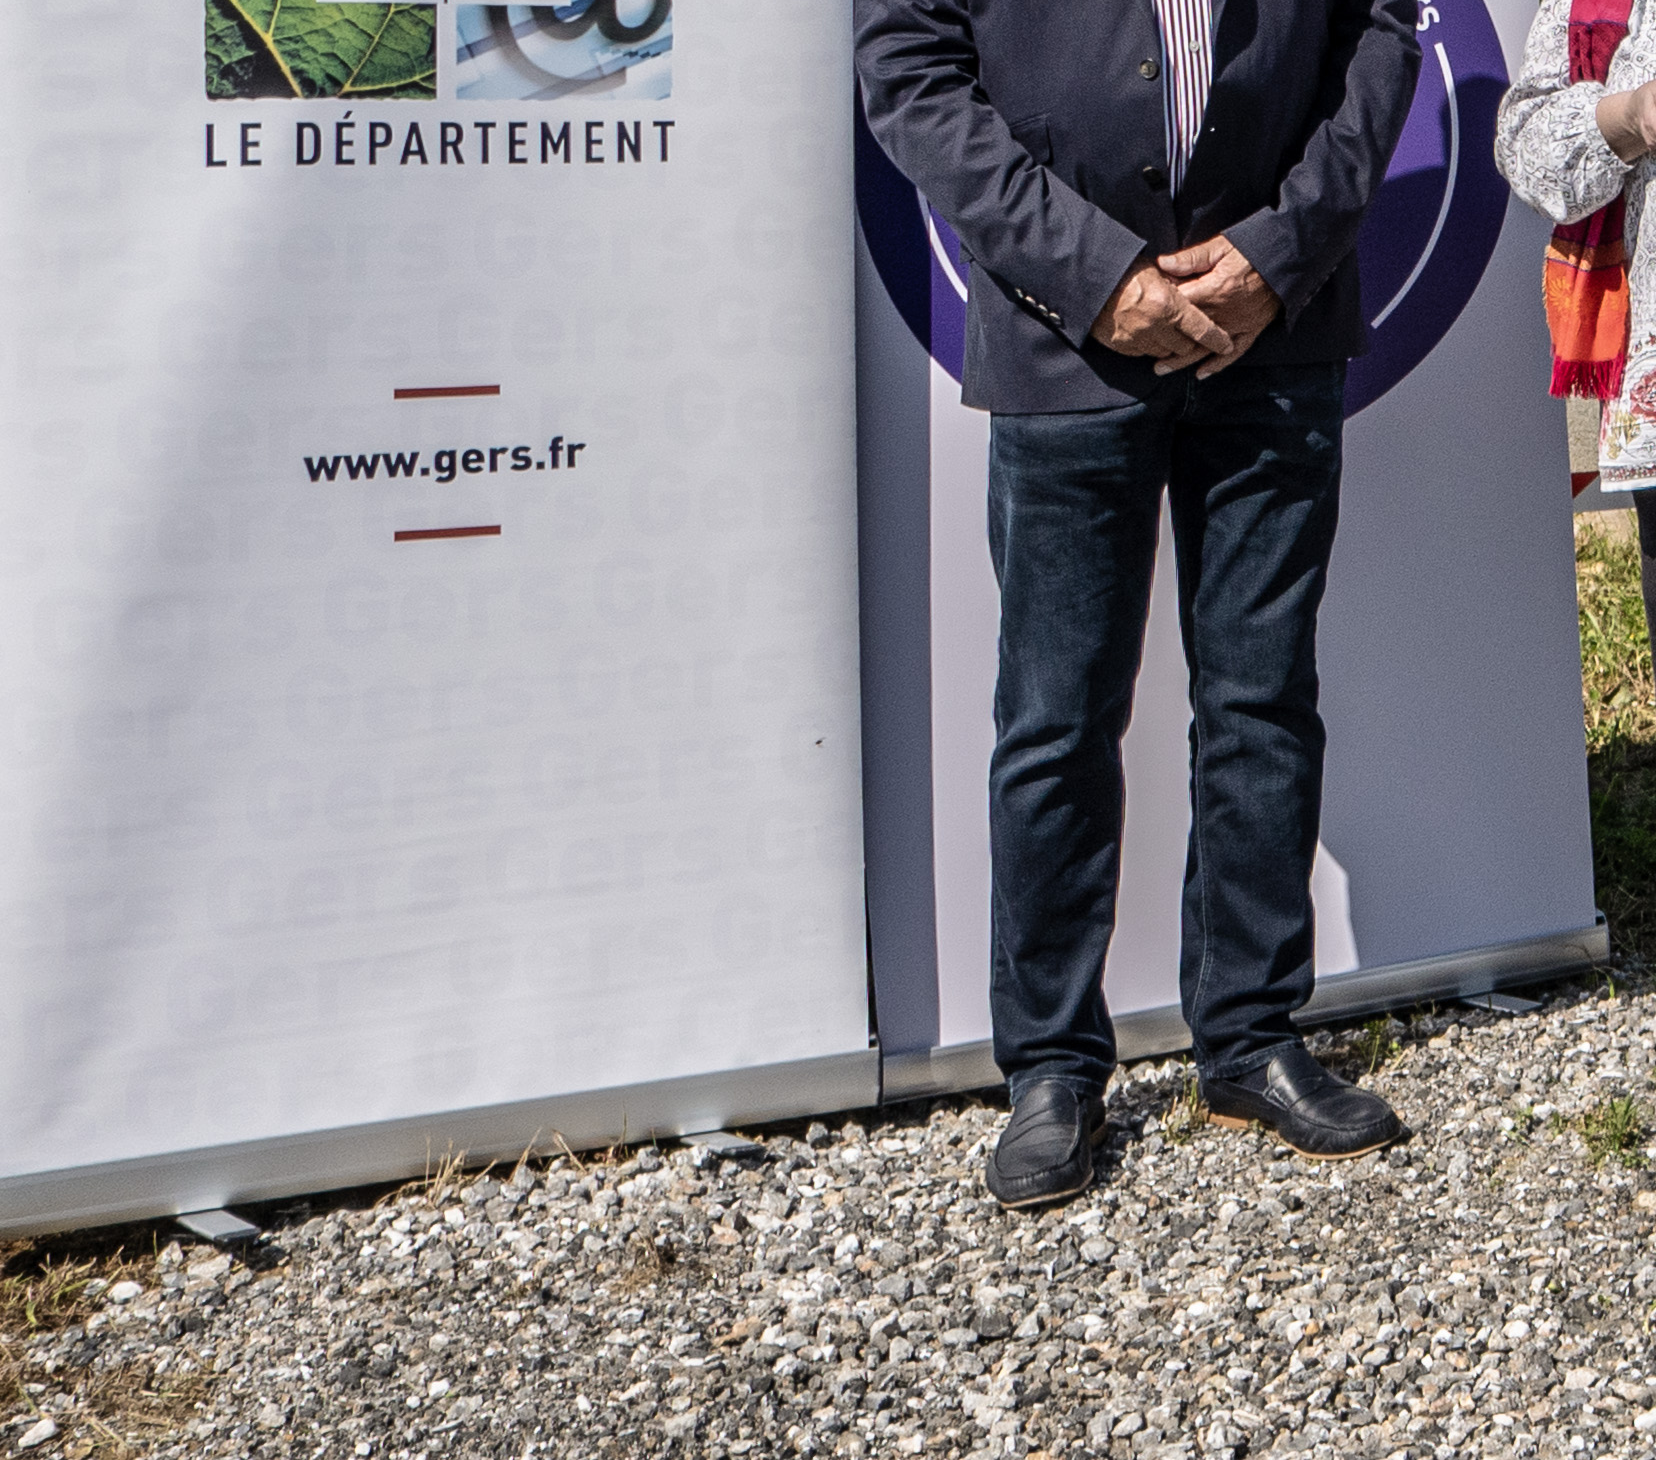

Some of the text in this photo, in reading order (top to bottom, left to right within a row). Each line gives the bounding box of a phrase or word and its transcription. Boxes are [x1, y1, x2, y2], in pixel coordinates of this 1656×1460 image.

[205, 110, 675, 167] LE DÉPARTEMENT
[303, 436, 586, 483] www.gers.fr
